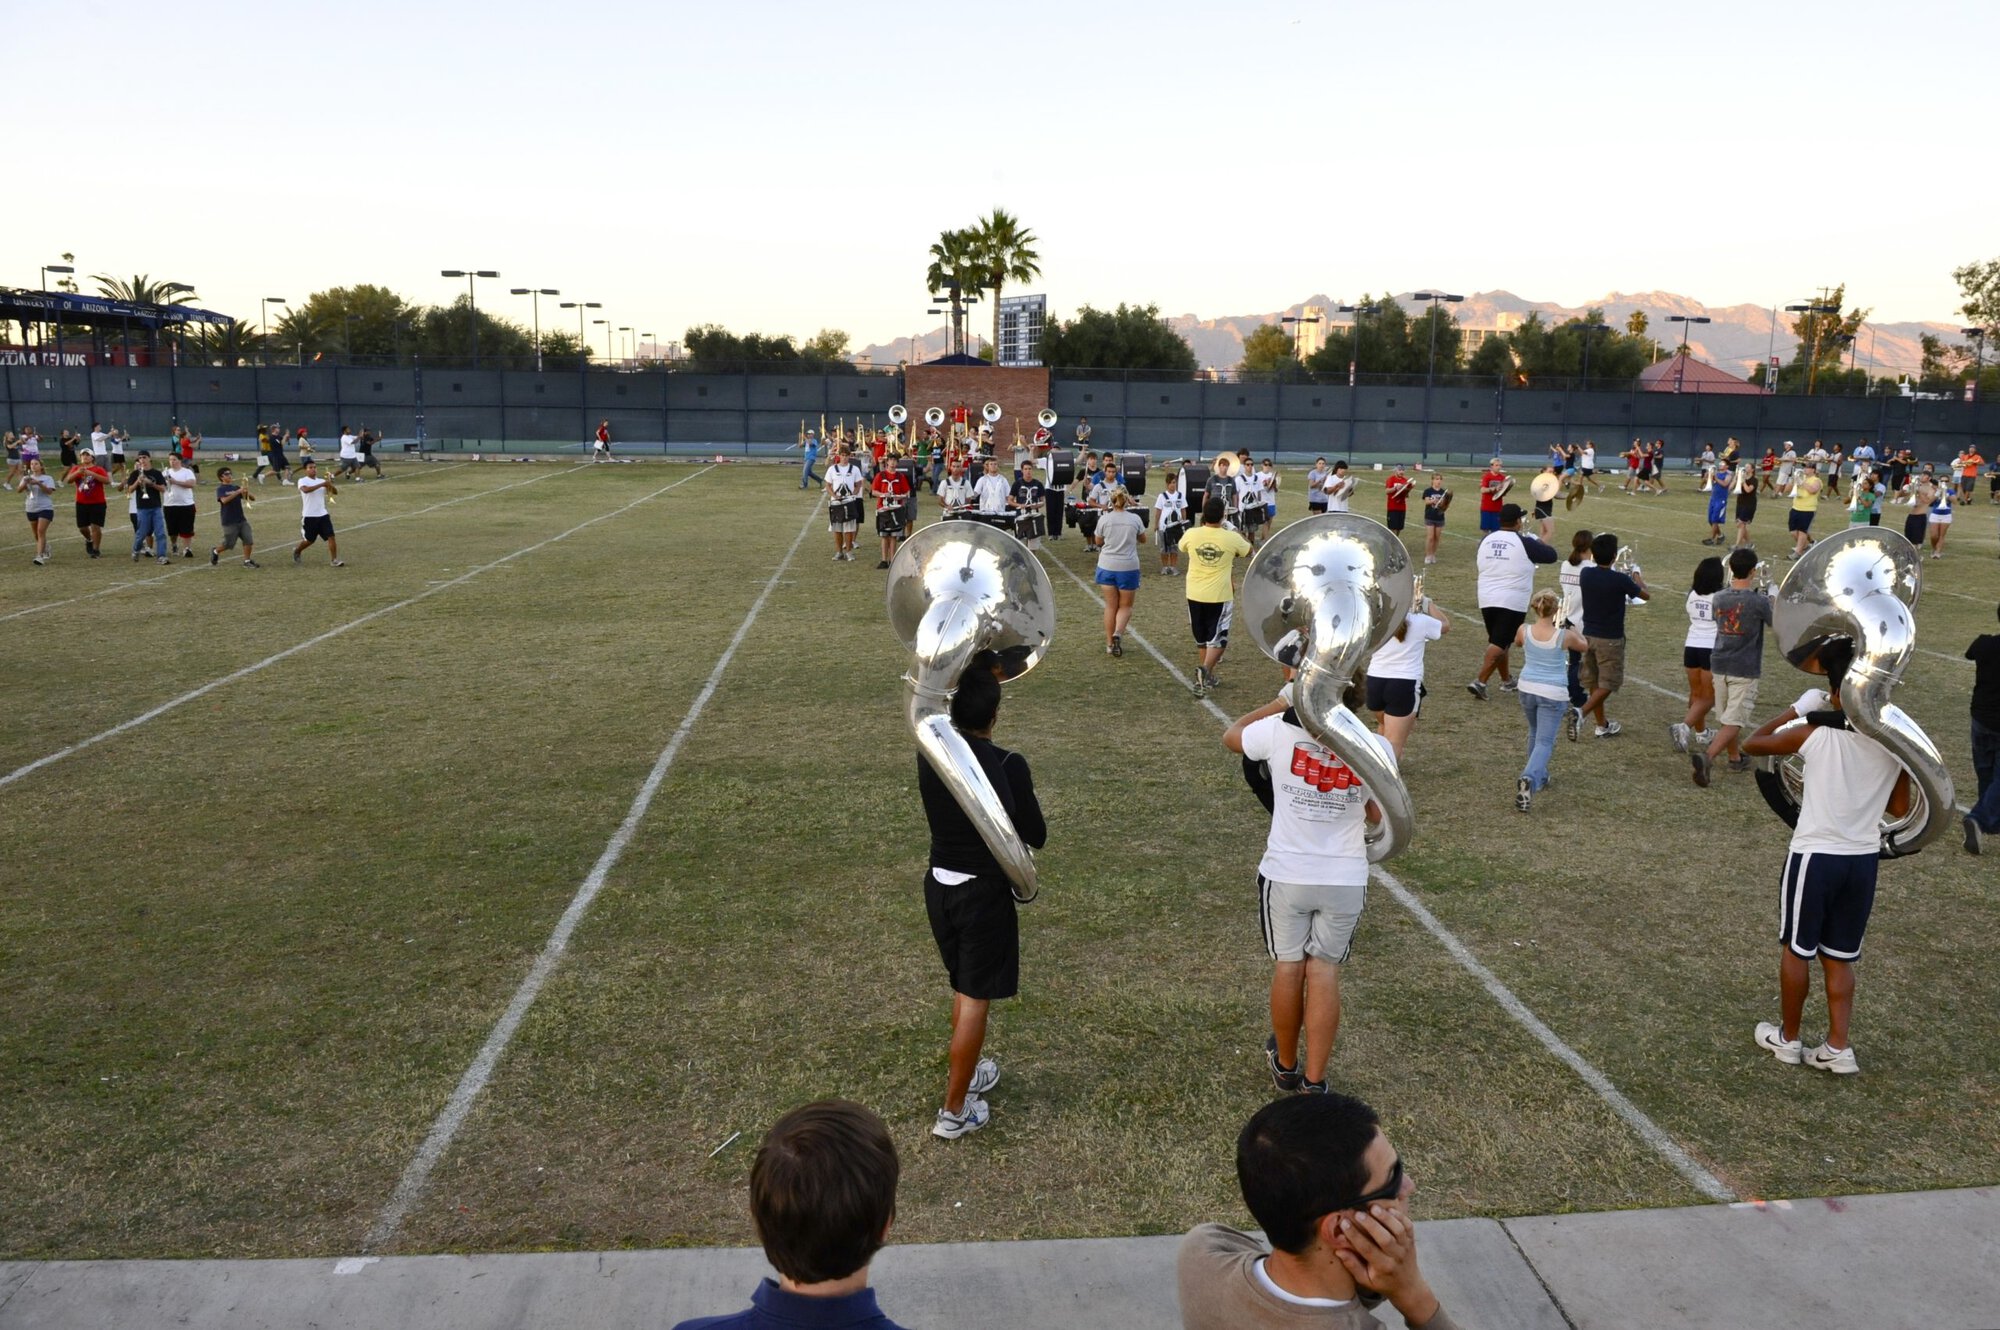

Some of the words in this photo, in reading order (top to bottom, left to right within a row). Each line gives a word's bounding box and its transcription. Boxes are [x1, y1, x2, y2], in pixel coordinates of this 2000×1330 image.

[63, 301, 72, 310] OF
[82, 303, 110, 313] ARIZONA
[1282, 784, 1317, 798] CAMPUS
